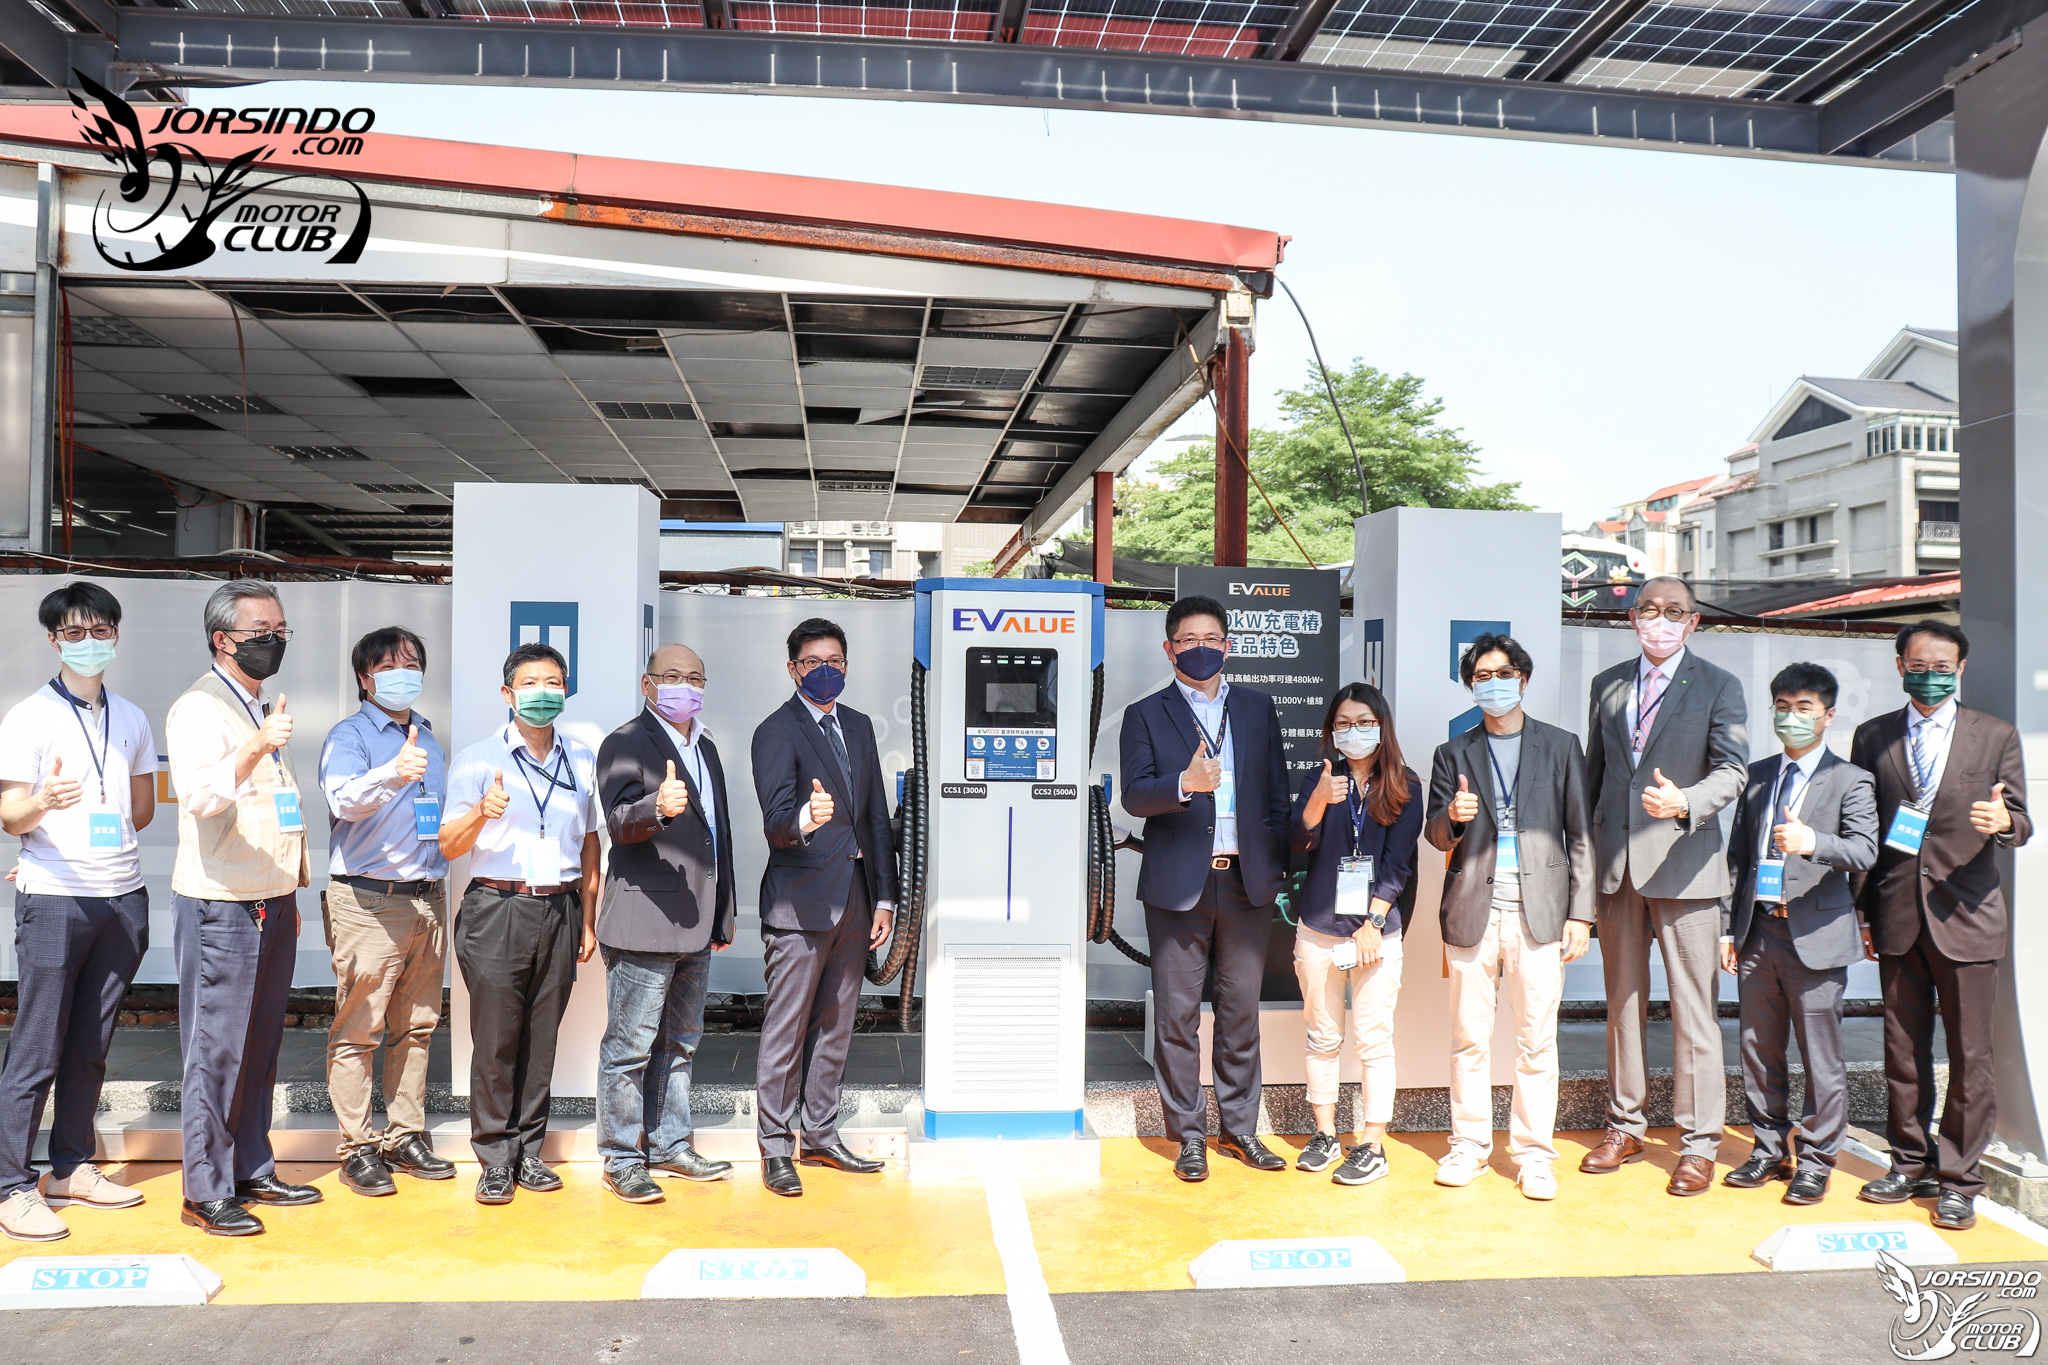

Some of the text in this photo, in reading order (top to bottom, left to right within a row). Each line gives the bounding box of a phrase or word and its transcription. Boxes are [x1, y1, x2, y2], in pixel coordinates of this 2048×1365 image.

[1228, 582, 1291, 597] EVALUE
[952, 608, 1075, 633] EVALUE
[962, 786, 986, 796] (300A)
[1034, 787, 1076, 797] CCS2 (500A)
[1819, 1232, 1906, 1252] STOP
[1251, 1250, 1350, 1269] STOP
[33, 1269, 148, 1289] STOP
[702, 1260, 807, 1279] STOP
